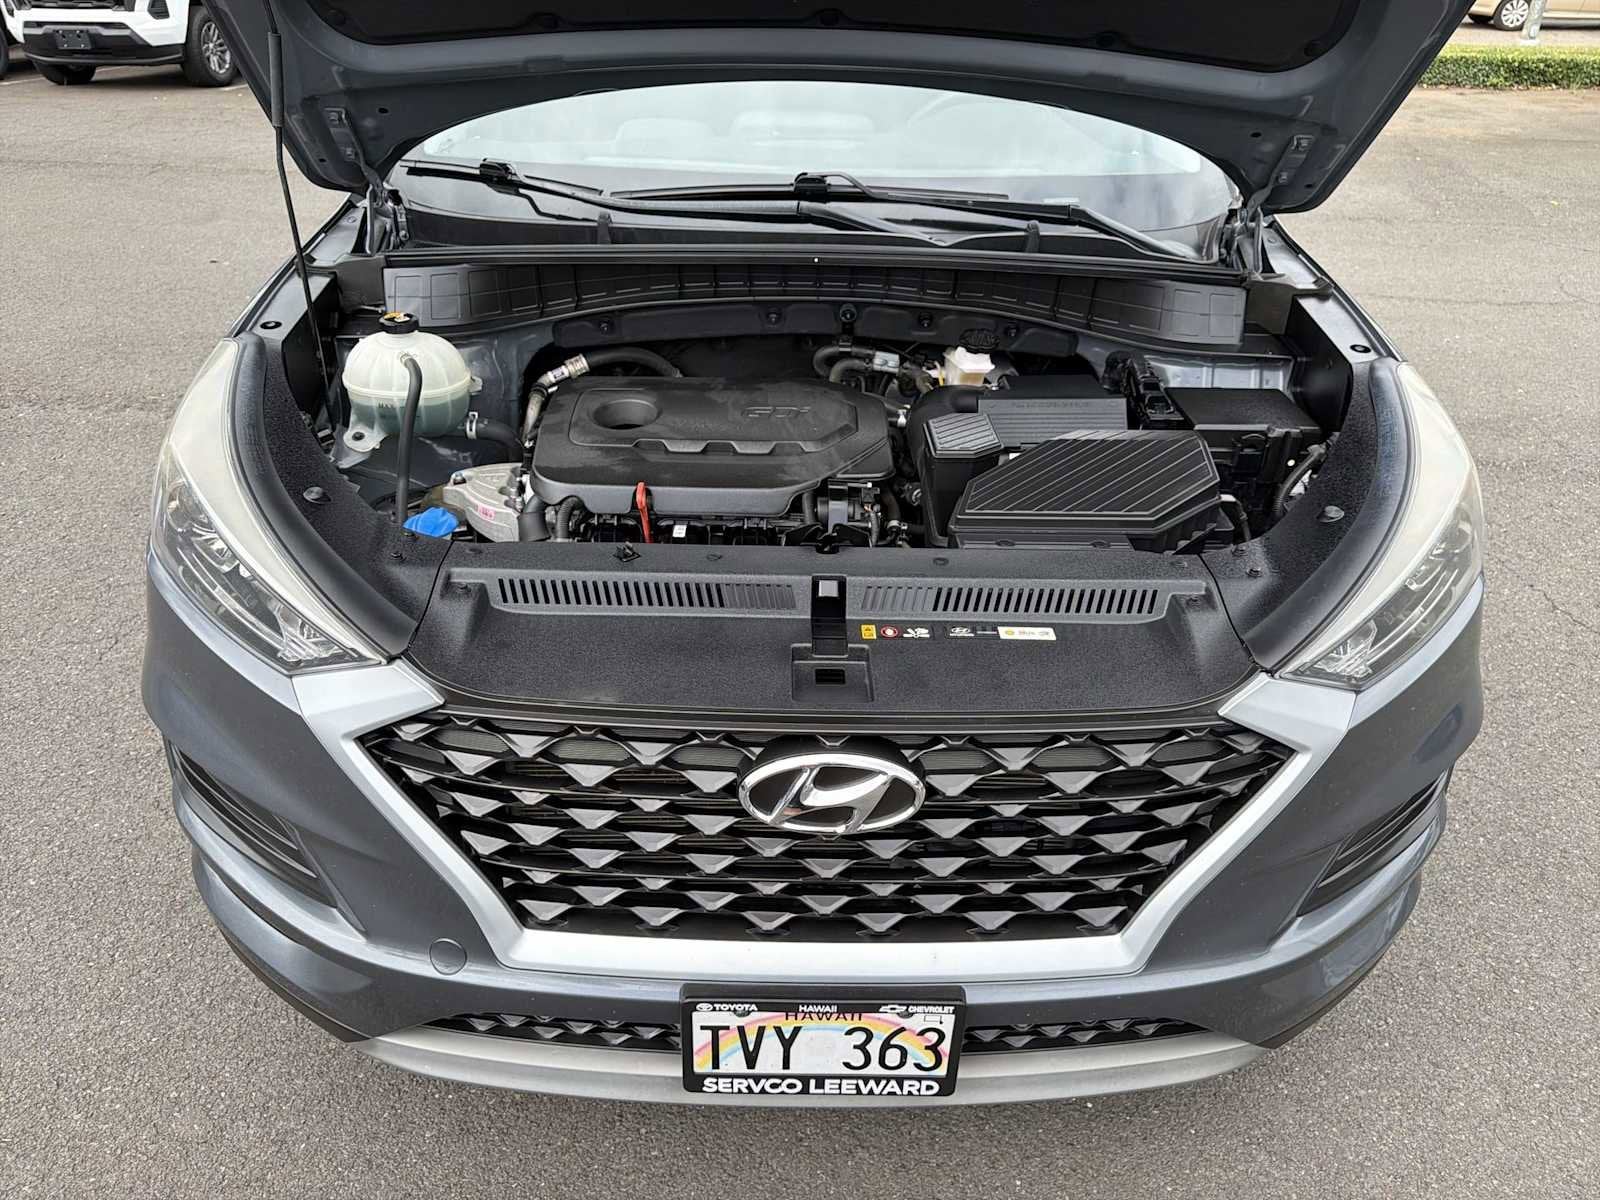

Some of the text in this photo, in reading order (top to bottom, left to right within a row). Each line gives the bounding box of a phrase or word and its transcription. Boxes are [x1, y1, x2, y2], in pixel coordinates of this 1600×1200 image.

[714, 1004, 758, 1012] TOYOTA
[799, 1004, 837, 1013] HAWAII
[908, 1005, 955, 1014] CHEVROLET
[785, 1012, 863, 1022] HAWAII
[700, 1025, 946, 1072] TVY 363
[702, 1077, 940, 1096] SERVCO LEEWARD
